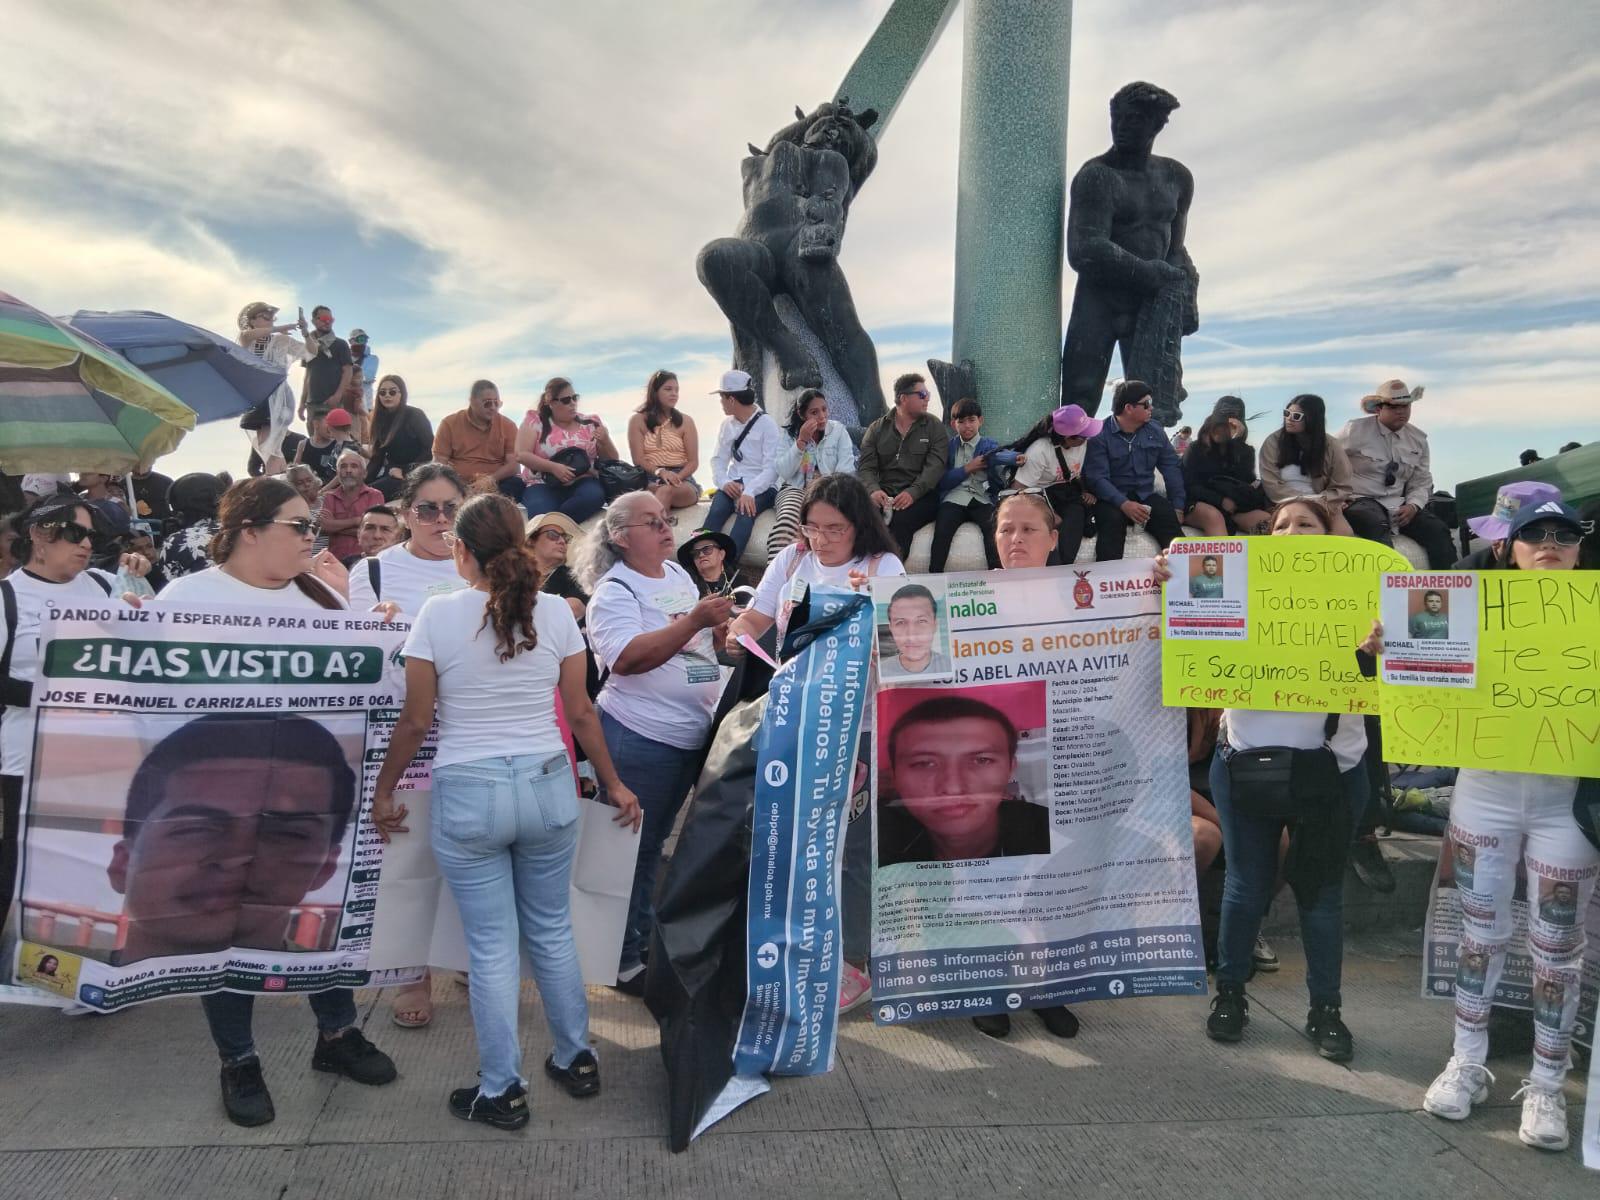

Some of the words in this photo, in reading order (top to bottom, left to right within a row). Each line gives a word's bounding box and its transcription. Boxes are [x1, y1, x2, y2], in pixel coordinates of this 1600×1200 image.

[1170, 542, 1243, 554] DESAPARECIDO
[1259, 551, 1284, 573] NO
[958, 580, 978, 588] Estatal
[961, 589, 969, 597] de
[1099, 577, 1160, 593] SINALOA
[1386, 575, 1473, 589] DESAPARECIDO
[1100, 591, 1129, 600] GOBIERNO
[1131, 590, 1142, 598] DEL
[1256, 586, 1319, 611] Todos
[1326, 597, 1358, 611] nos
[50, 608, 111, 622] DANDO
[118, 609, 149, 623] LUZ
[156, 611, 166, 623] Y
[172, 612, 262, 627] ESPERANZA
[267, 616, 307, 630] PARA
[312, 618, 339, 631] QUE
[344, 619, 412, 633] REGRESEN
[1224, 629, 1242, 637] mucho
[1021, 637, 1034, 651] a
[1041, 625, 1142, 651] encontrar
[1148, 626, 1160, 641] a
[1257, 621, 1359, 648] MICHAEL
[1384, 640, 1415, 649] MICHAEL
[72, 643, 191, 678] ¿HAS
[200, 649, 314, 678] VISTO
[323, 651, 366, 678] A?
[972, 664, 1013, 682] ABEL
[1016, 658, 1078, 678] AMAYA
[1082, 652, 1129, 673] AVITIA
[1493, 639, 1547, 674] te
[1390, 673, 1400, 681] Su
[1399, 673, 1419, 682] familia
[1426, 675, 1449, 683] extraña
[1450, 676, 1470, 685] mucho
[39, 690, 87, 704] JOSE
[93, 692, 177, 709] EMANUEL
[184, 696, 283, 710] CARRIZALES
[288, 695, 345, 708] MONTES
[348, 695, 364, 707] DE
[368, 694, 394, 706] OCA
[815, 635, 839, 767] escribenos.
[1274, 690, 1328, 708] pronto
[833, 659, 864, 792] información
[1443, 706, 1511, 760] TE
[812, 772, 830, 800] Tu
[805, 806, 823, 872] ayuda
[805, 877, 818, 902] es
[825, 906, 834, 920] a
[799, 907, 817, 953] muy
[819, 930, 834, 972] esta
[878, 960, 891, 973] Si
[896, 957, 937, 970] tienes
[943, 949, 1024, 966] información
[1031, 943, 1085, 960] referente
[1090, 941, 1098, 950] a
[1103, 936, 1131, 948] esta
[1137, 933, 1196, 947] persona,
[1434, 946, 1448, 956] Si
[104, 971, 155, 988] LLAMADA
[158, 968, 166, 976] O
[169, 964, 220, 975] MENSAJE
[878, 975, 914, 989] llama
[917, 975, 926, 984] o
[929, 968, 1008, 983] escribenos.
[1012, 964, 1028, 977] Tu
[1031, 960, 1070, 977] ayuda
[1073, 958, 1087, 969] es
[1089, 953, 1118, 966] muy
[1121, 947, 1198, 963] importante.
[916, 1001, 939, 1013] 669
[941, 999, 961, 1010] 327
[963, 996, 992, 1008] 8424
[1506, 990, 1529, 1000] 327
[786, 957, 815, 1068] importante.
